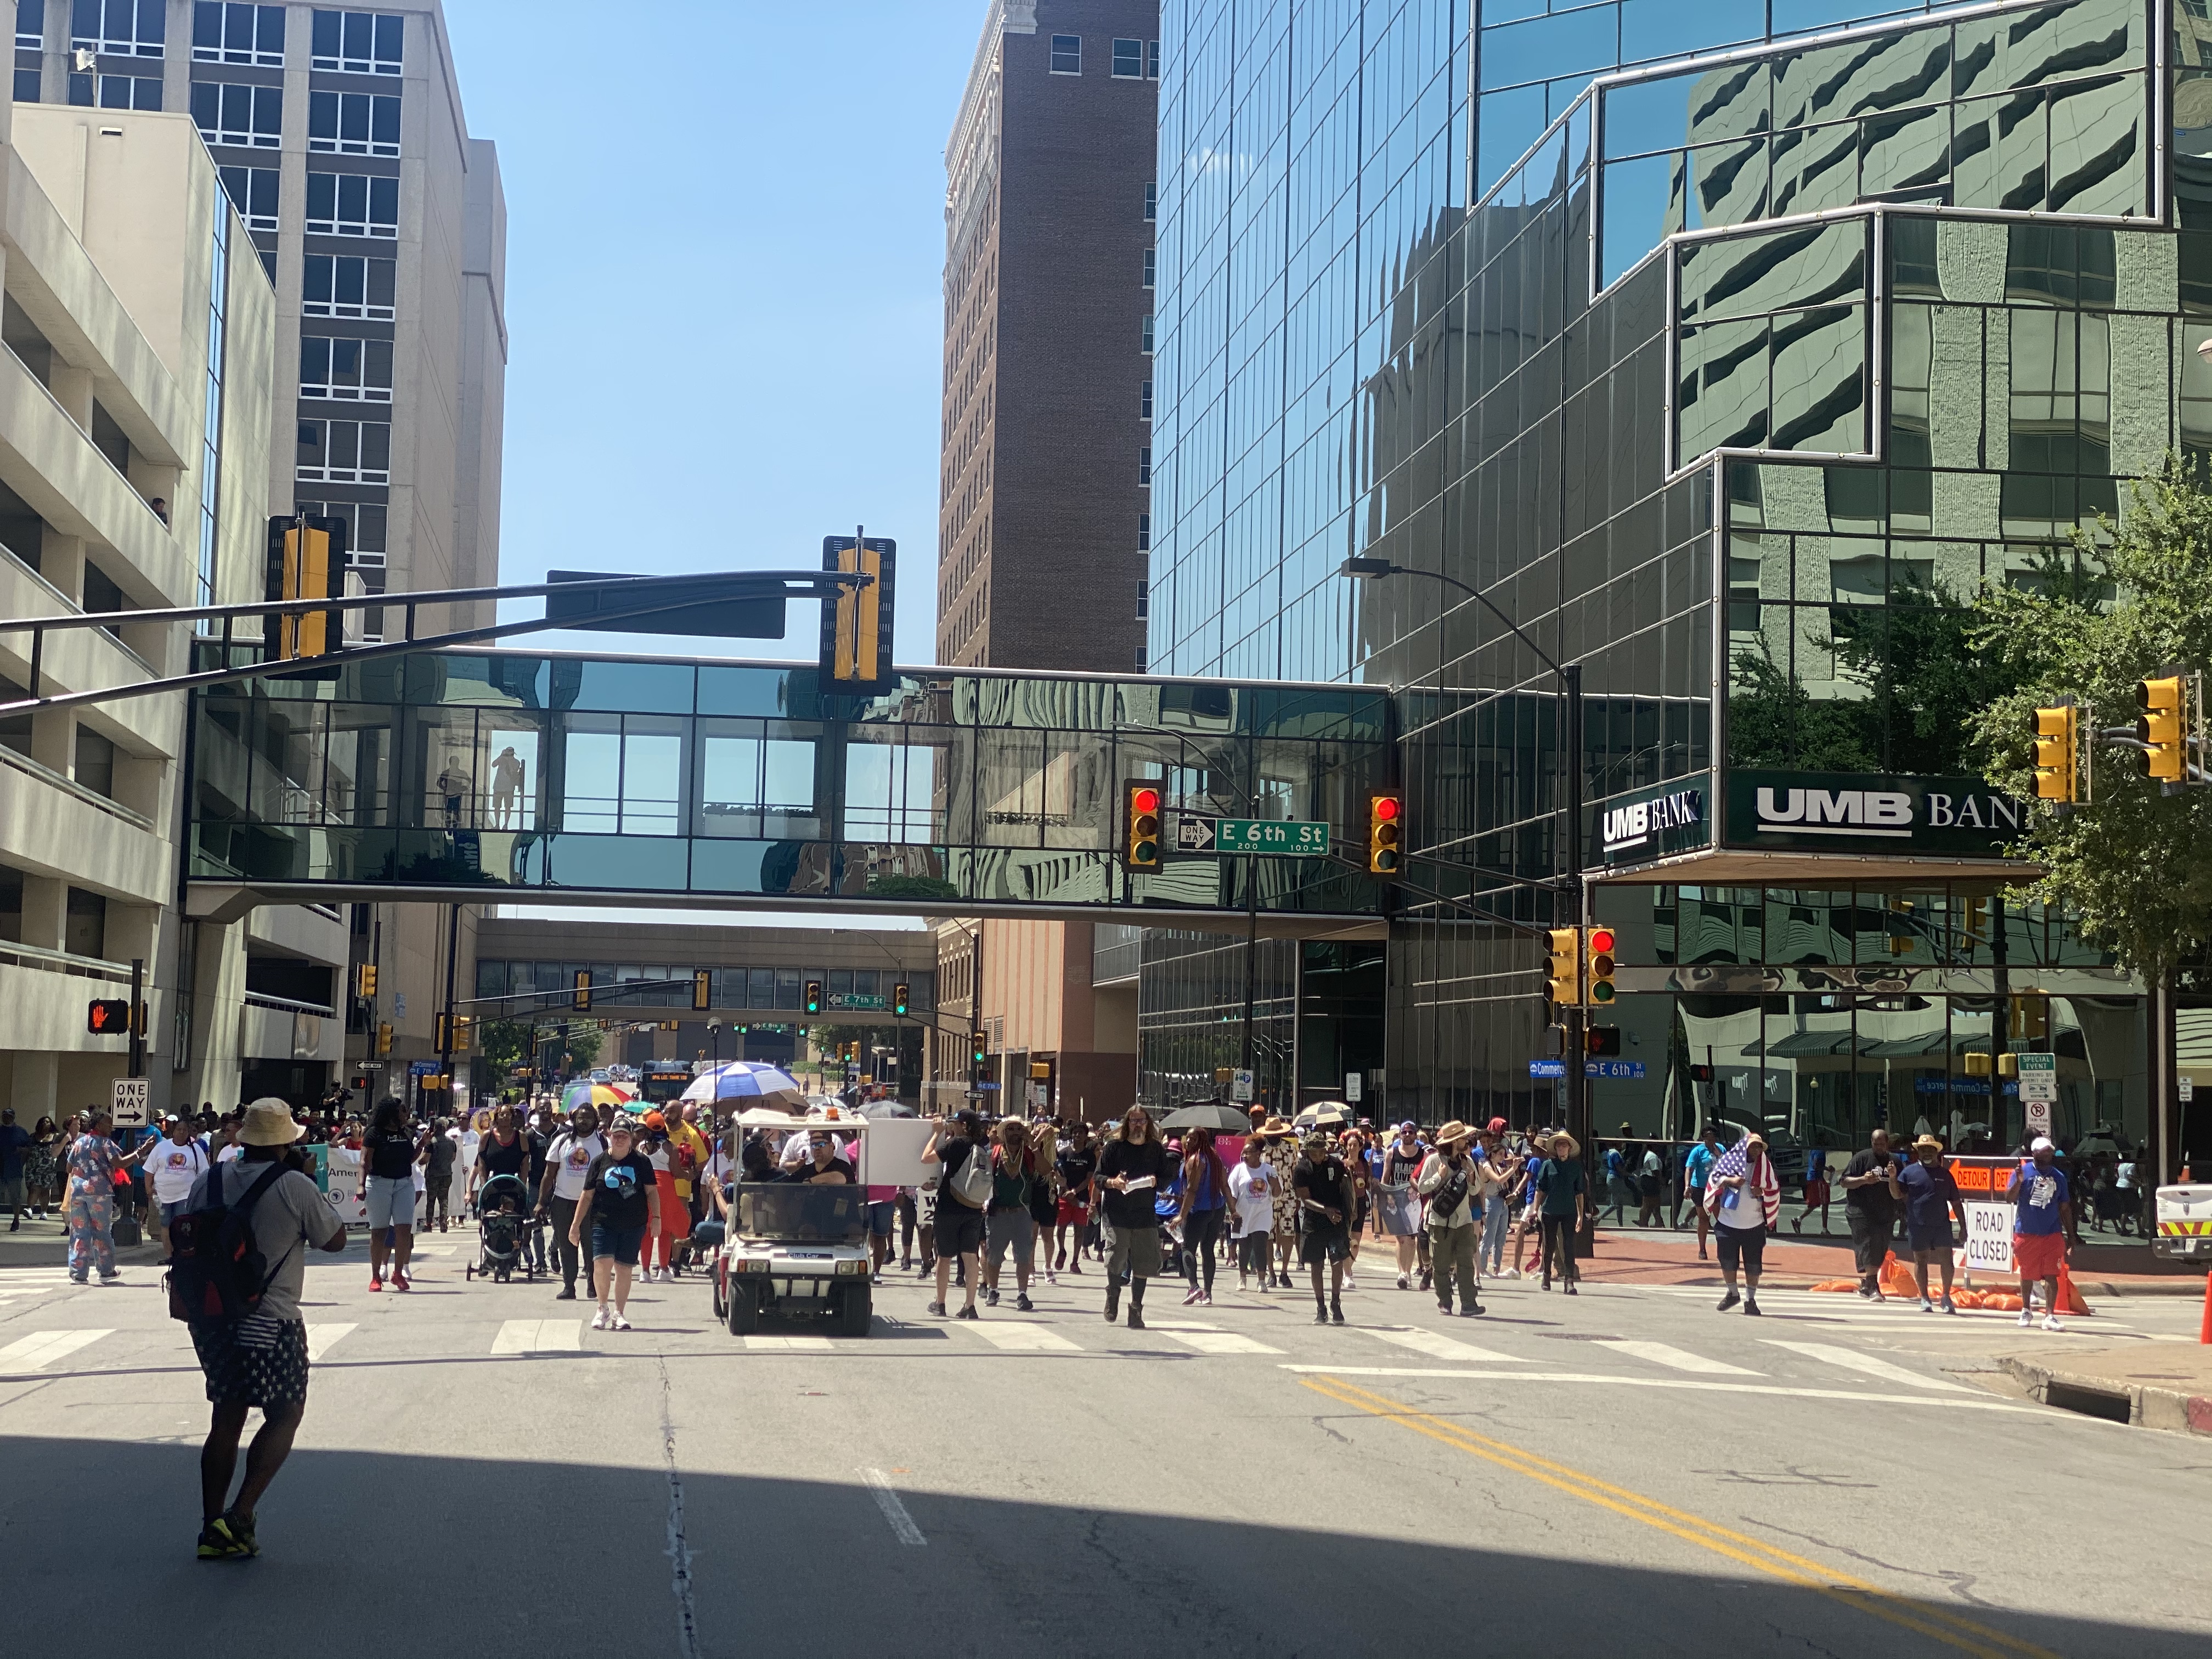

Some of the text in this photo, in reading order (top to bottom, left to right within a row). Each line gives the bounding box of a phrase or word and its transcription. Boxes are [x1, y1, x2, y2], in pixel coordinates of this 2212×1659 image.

[1757, 787, 1913, 825] UMB
[1604, 790, 1692, 842] UMB BANK
[1223, 823, 1322, 843] E 6th St
[1537, 1062, 1565, 1075] Commerce
[1600, 1063, 1630, 1076] E 6th
[117, 1084, 145, 1095] ONE
[116, 1097, 145, 1108] WAY
[328, 1167, 358, 1177] Amer
[1395, 1163, 1417, 1173] BLAC
[1958, 1171, 1988, 1188] DETOUR
[1976, 1211, 2003, 1232] ROAD
[1970, 1239, 2008, 1261] CLOSED
